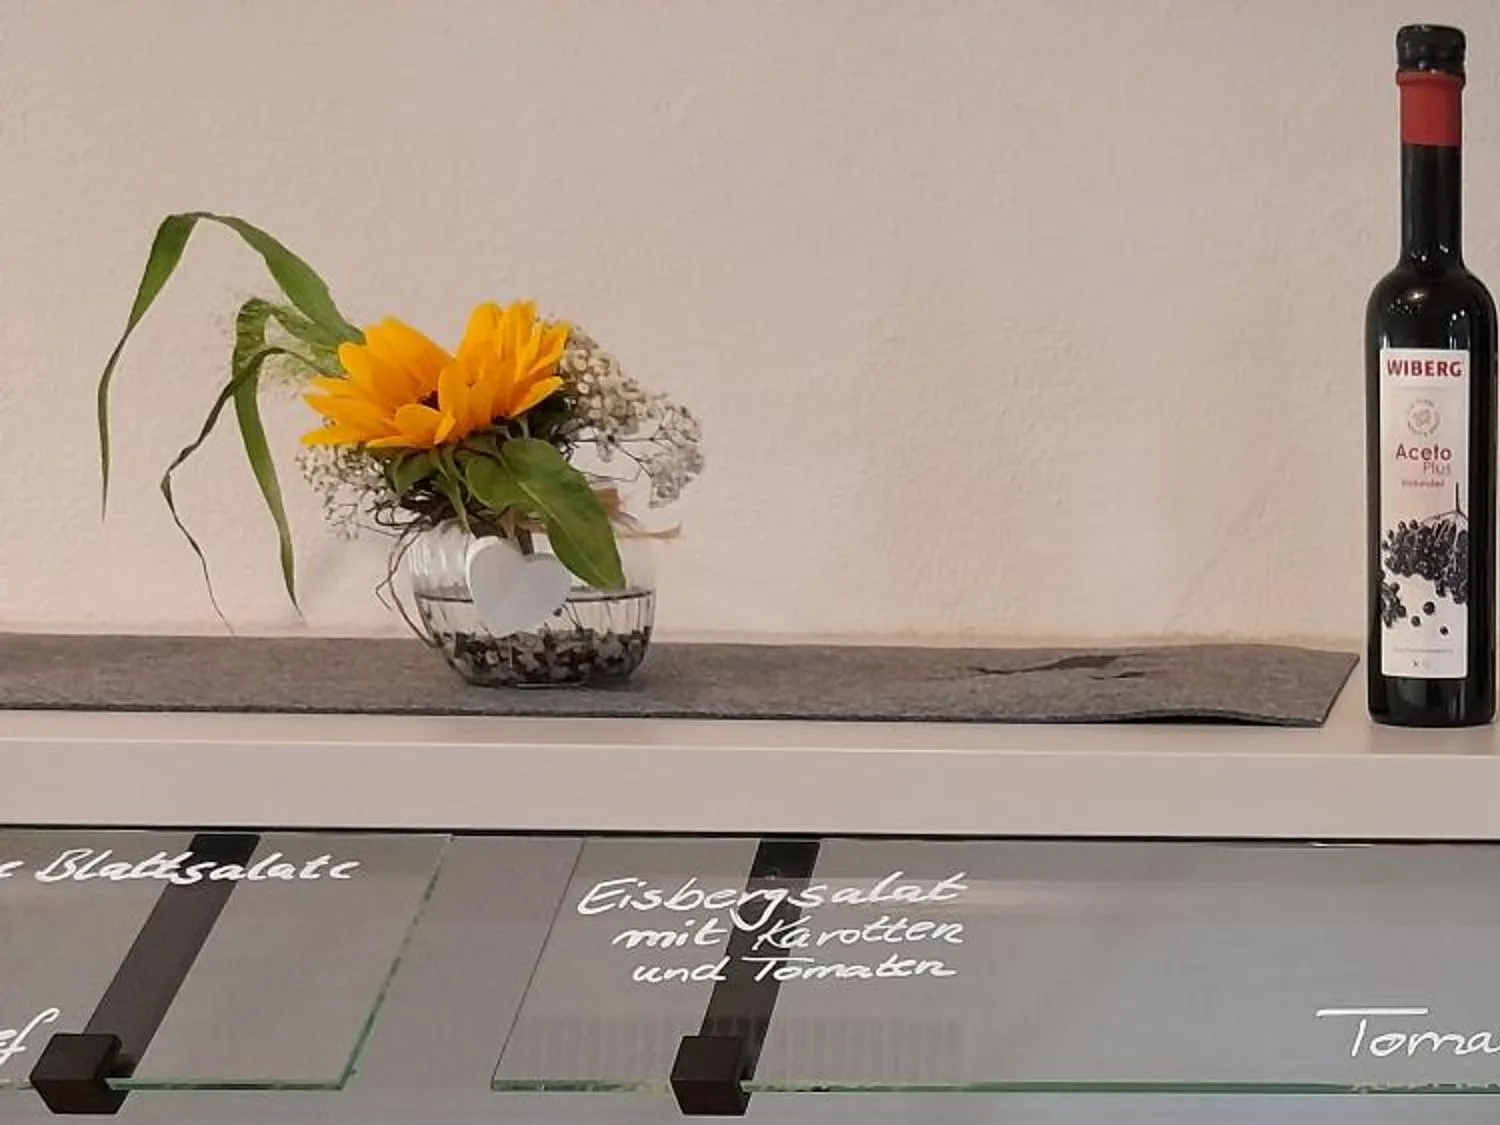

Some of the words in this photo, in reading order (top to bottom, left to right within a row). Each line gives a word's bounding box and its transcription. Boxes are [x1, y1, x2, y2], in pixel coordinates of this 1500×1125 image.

[1386, 359, 1463, 377] WIBERG
[35, 848, 361, 885] Blattsalate
[577, 871, 968, 932] Eisbergsalat
[612, 918, 728, 949] mit
[752, 916, 964, 951] Karotten
[632, 957, 727, 984] und
[741, 953, 957, 984] Tomaten
